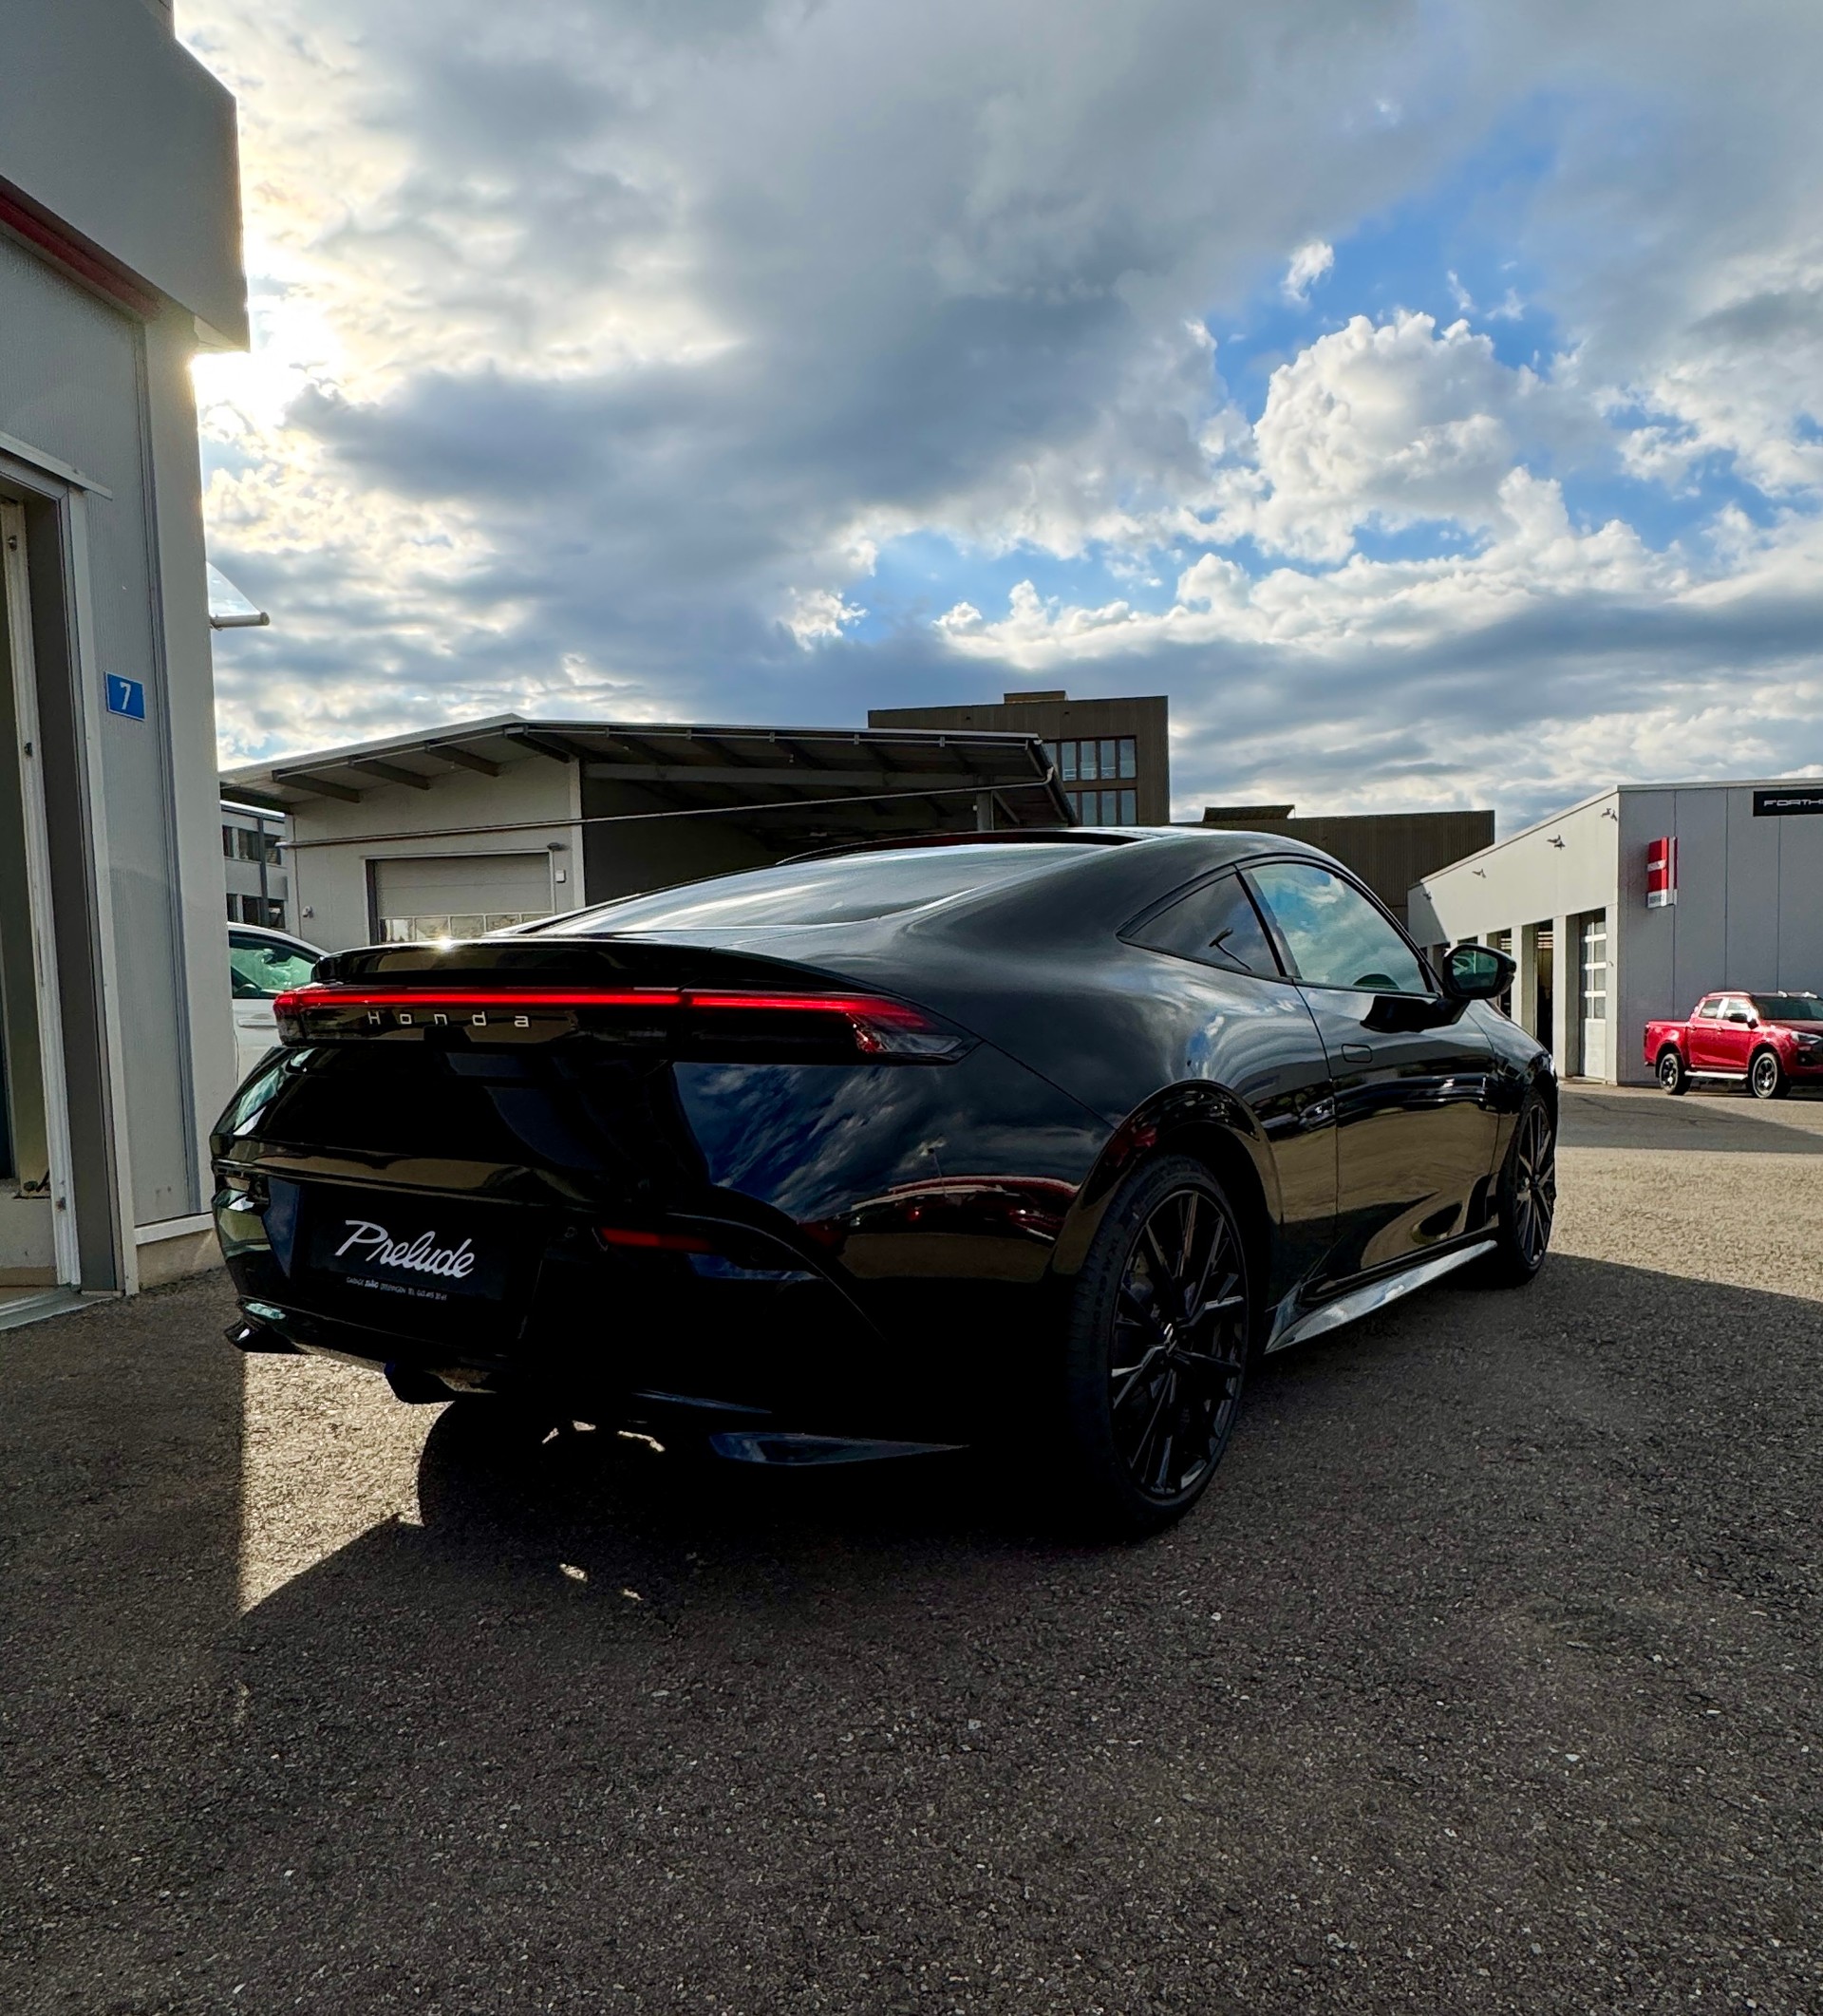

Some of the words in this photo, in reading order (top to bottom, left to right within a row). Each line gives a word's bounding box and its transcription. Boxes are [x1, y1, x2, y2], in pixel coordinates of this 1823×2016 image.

[120, 682, 131, 710] 7
[367, 1009, 530, 1028] Honda
[335, 1220, 475, 1278] Prelude
